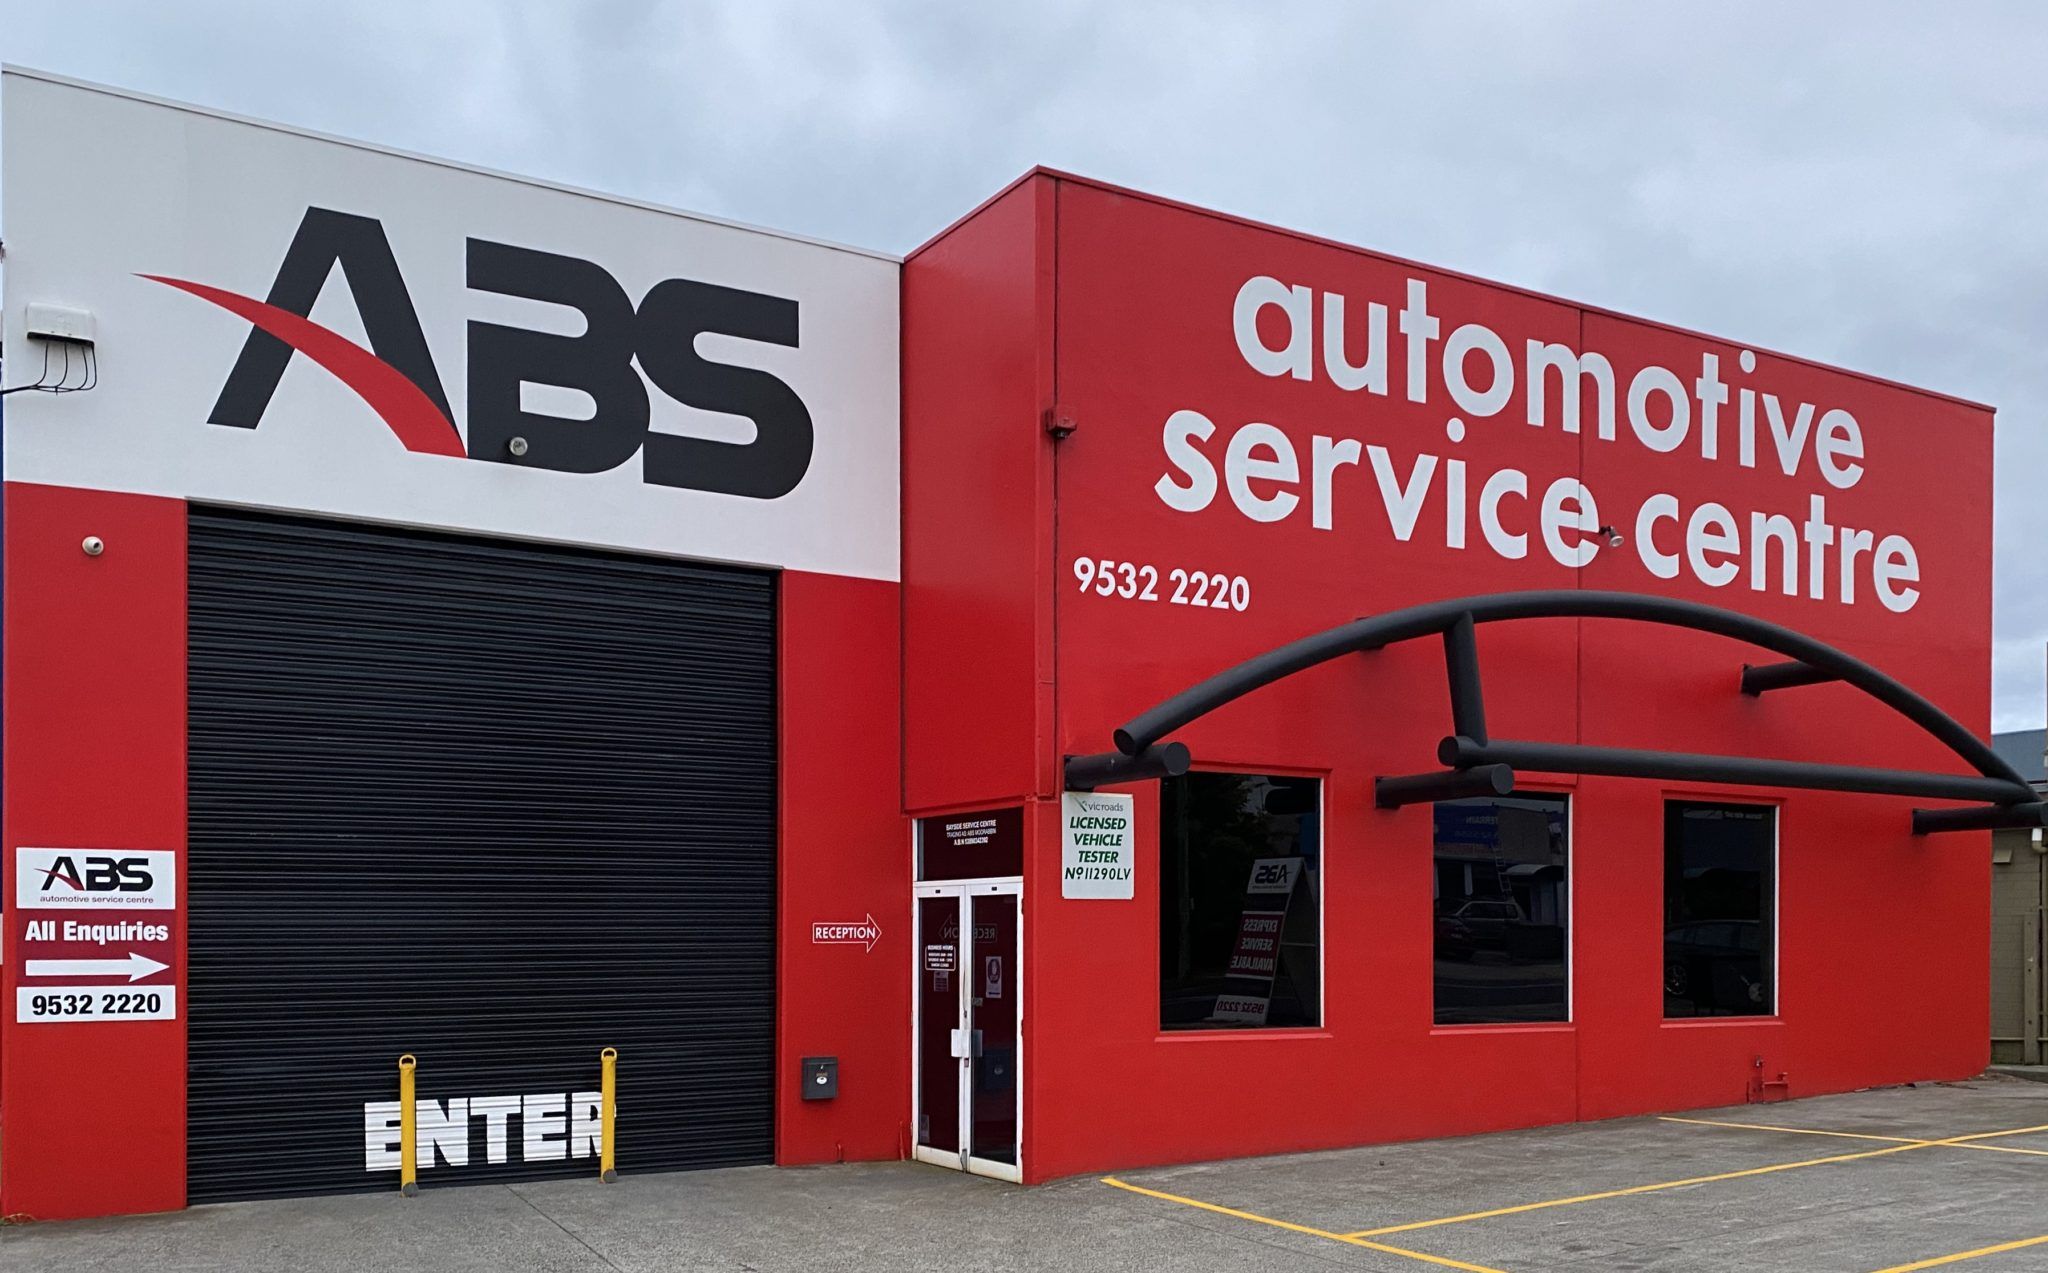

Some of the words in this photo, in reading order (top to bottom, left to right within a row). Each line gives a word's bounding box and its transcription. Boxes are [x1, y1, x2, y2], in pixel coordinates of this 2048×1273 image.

[134, 206, 814, 499] ABS
[1233, 275, 1864, 489] automotive
[1154, 410, 1600, 568] service
[1635, 494, 1921, 612] centre
[1073, 556, 1159, 602] 9532
[1169, 568, 1250, 612] 2220
[1070, 816, 1127, 830] LICENSED
[1074, 833, 1123, 846] VEHICLE
[1078, 850, 1119, 863] TESTER
[34, 856, 154, 891] ABS
[40, 895, 89, 903] automotive
[92, 895, 124, 903] service
[126, 896, 154, 904] centre
[25, 921, 56, 941] All
[63, 921, 169, 945] Enquiries
[815, 927, 876, 939] RECEPTION
[32, 995, 93, 1015] 9532
[102, 993, 161, 1014] 2220
[365, 1091, 617, 1172] ENTER
